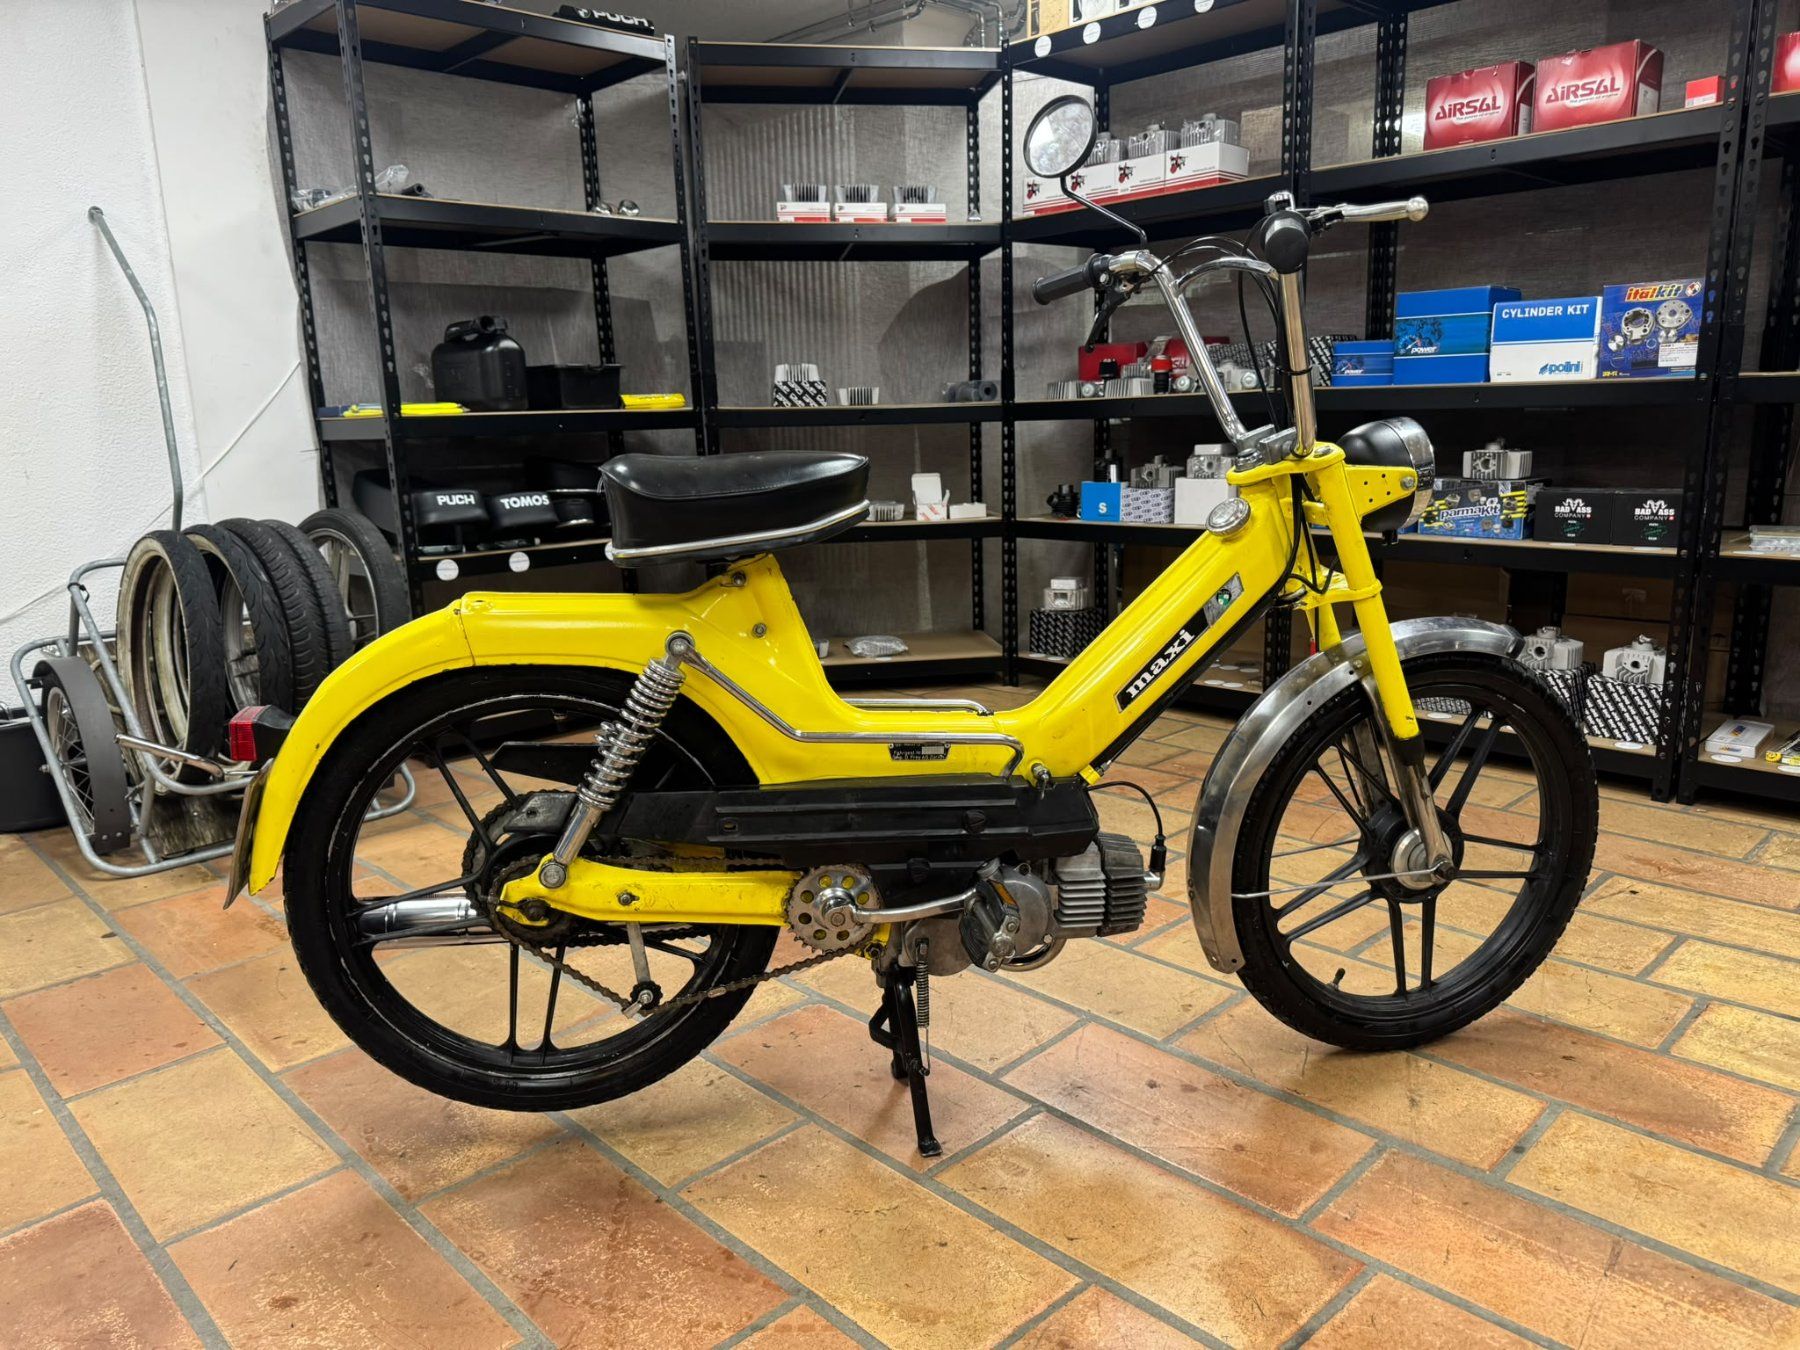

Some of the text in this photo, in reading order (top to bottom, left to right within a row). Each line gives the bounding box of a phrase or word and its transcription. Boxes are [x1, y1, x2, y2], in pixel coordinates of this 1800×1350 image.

[1625, 284, 1683, 302] italkit
[1502, 304, 1589, 318] CYLINDER KIT
[1548, 361, 1582, 374] polini
[436, 494, 475, 506] PUCH
[500, 495, 549, 509] TOMOS
[1098, 502, 1107, 513] S
[1126, 629, 1195, 698] maxi
